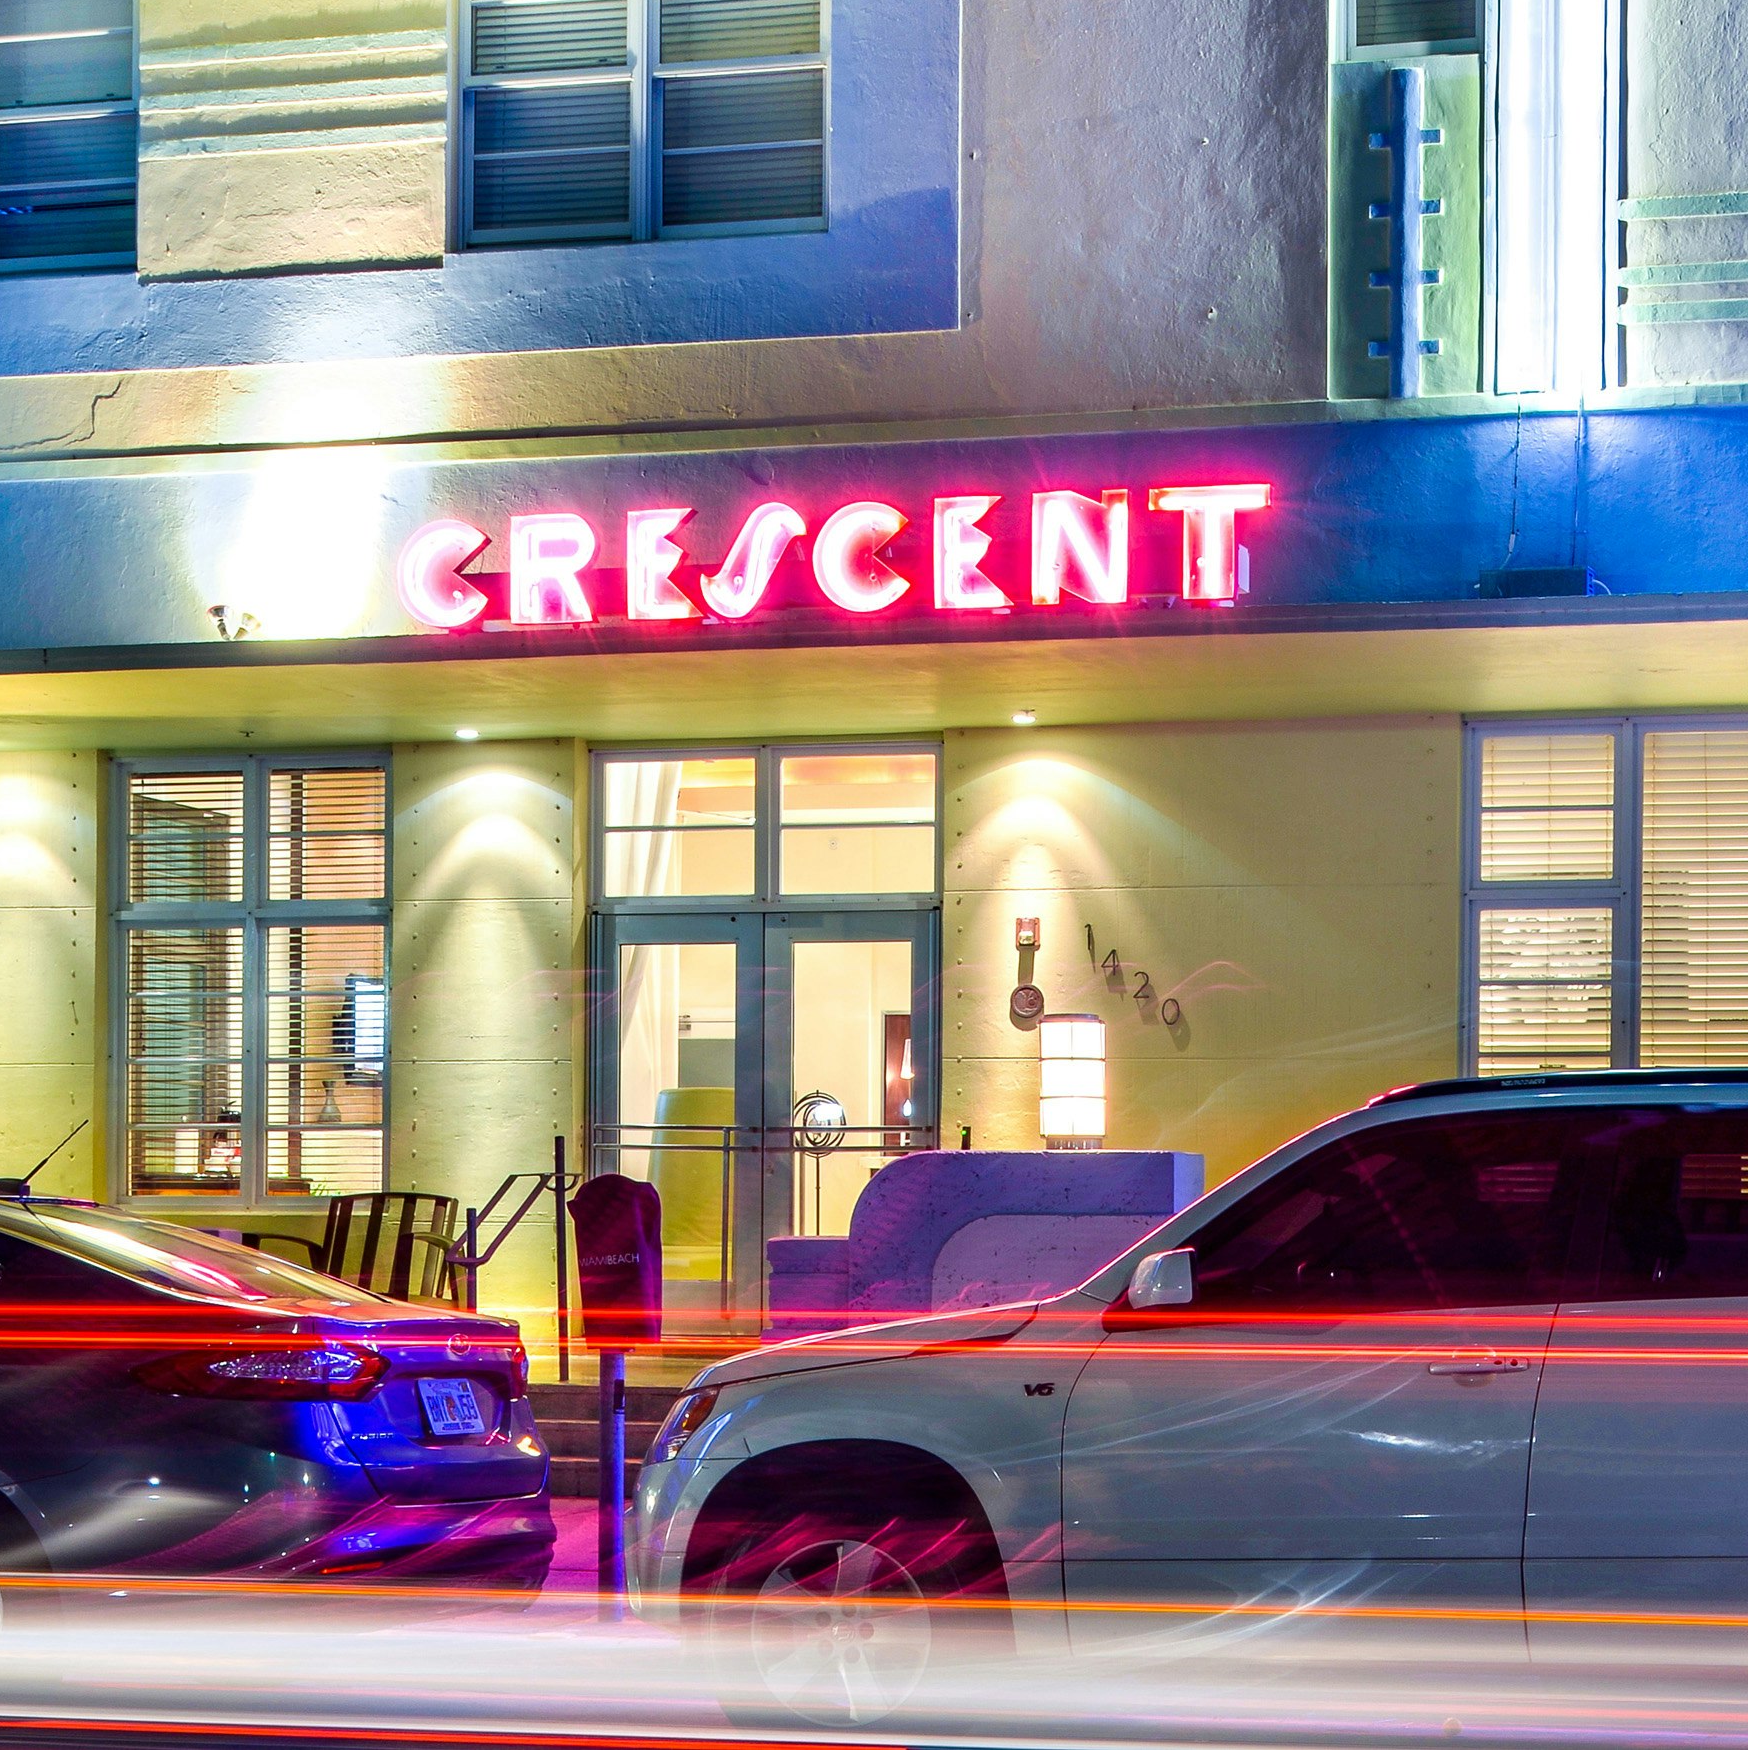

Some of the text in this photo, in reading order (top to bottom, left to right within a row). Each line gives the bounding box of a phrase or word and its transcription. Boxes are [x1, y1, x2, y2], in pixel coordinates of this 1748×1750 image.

[396, 483, 1272, 628] CRESCENT
[1084, 923, 1180, 1025] 1420
[1023, 1382, 1056, 1397] V6
